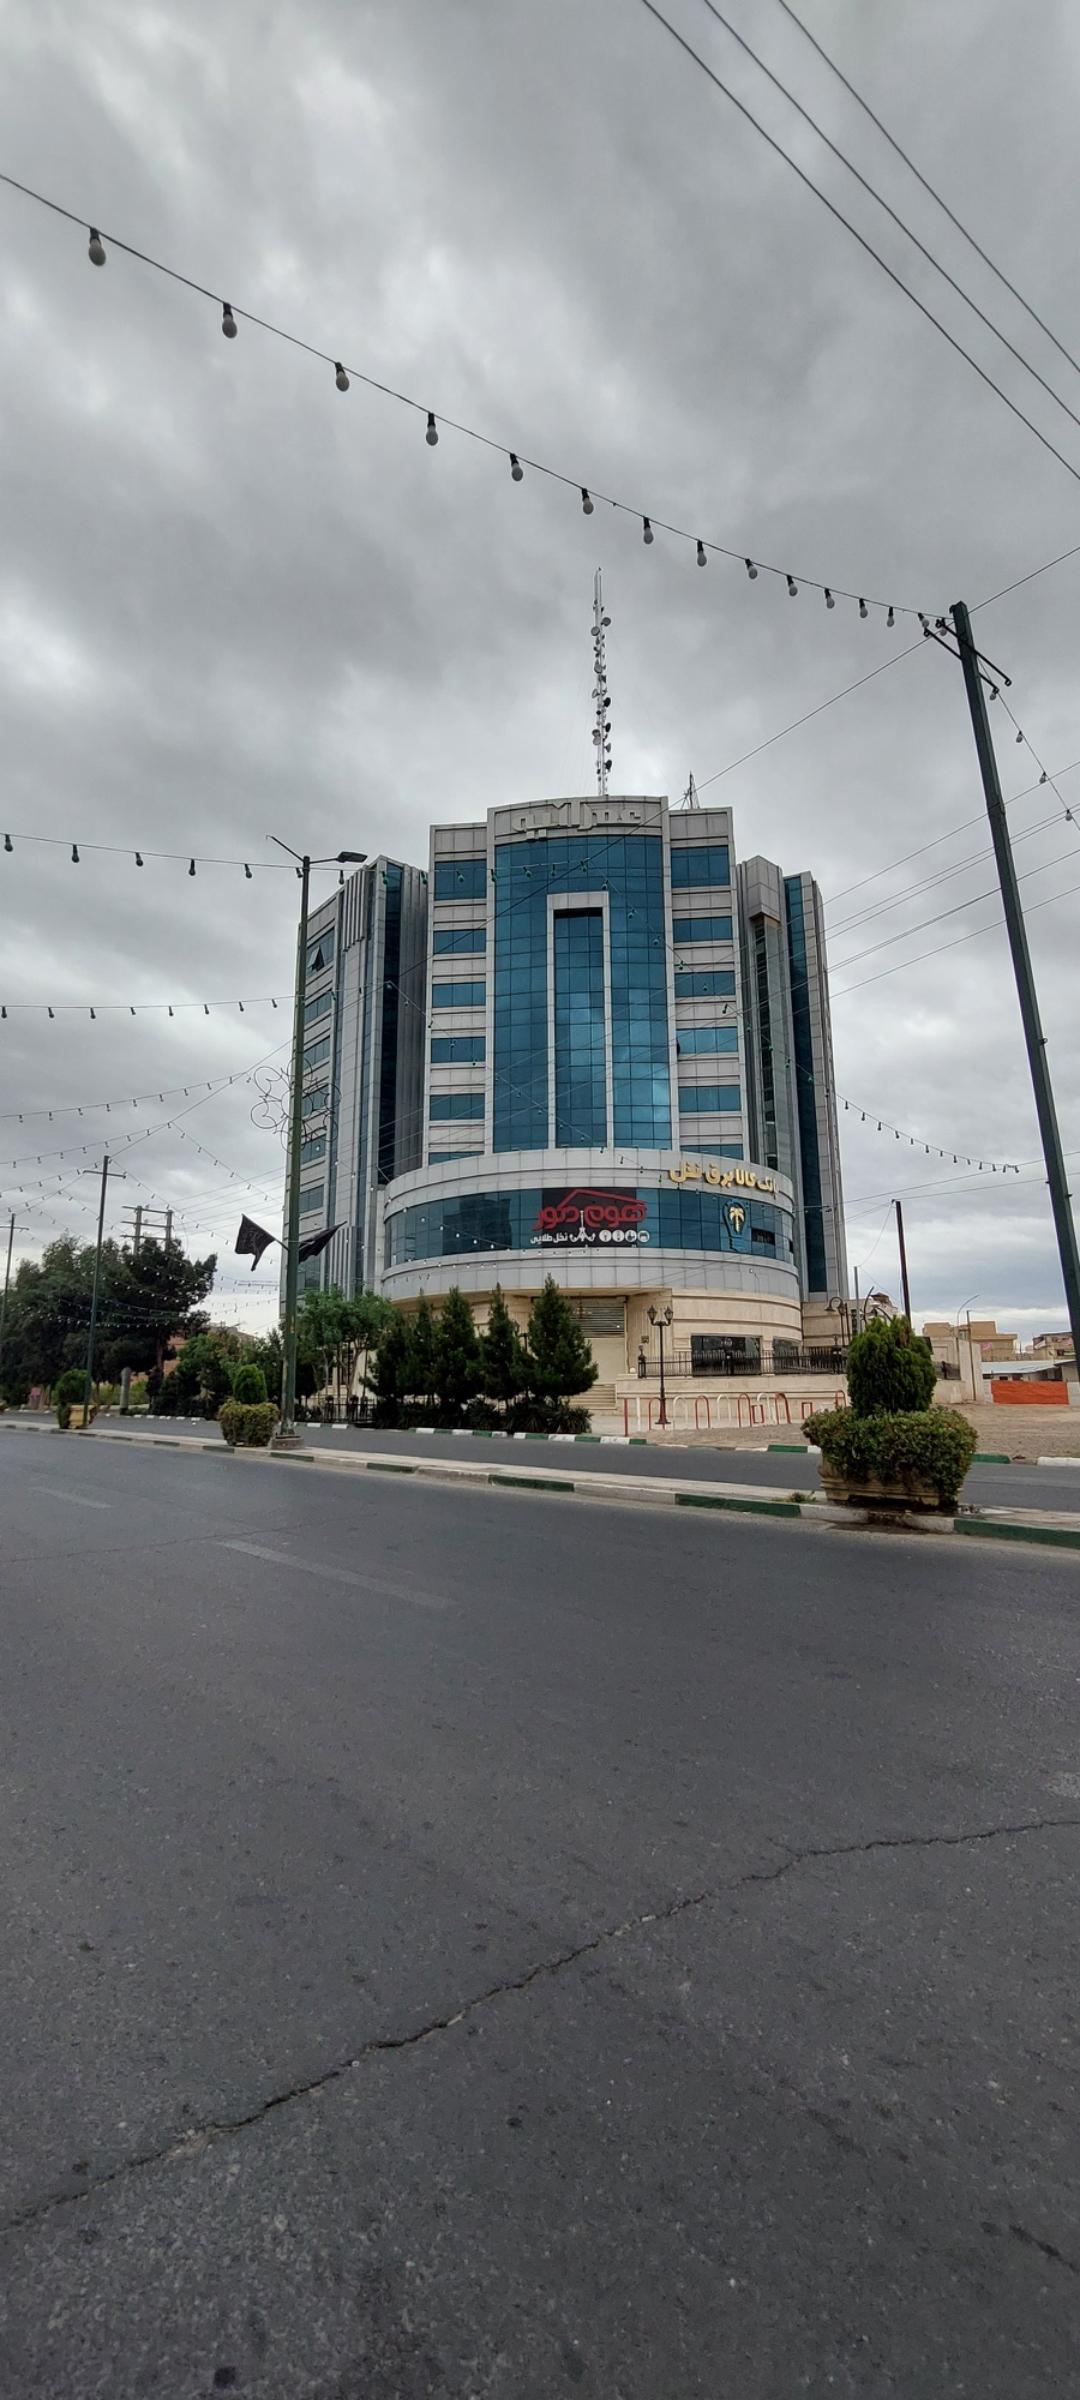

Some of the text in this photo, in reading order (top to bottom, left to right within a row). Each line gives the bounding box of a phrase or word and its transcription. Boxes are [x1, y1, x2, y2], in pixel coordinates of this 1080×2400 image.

[668, 1161, 703, 1183] نخل
[705, 1163, 734, 1189] برق
[584, 1204, 648, 1229] هوم
